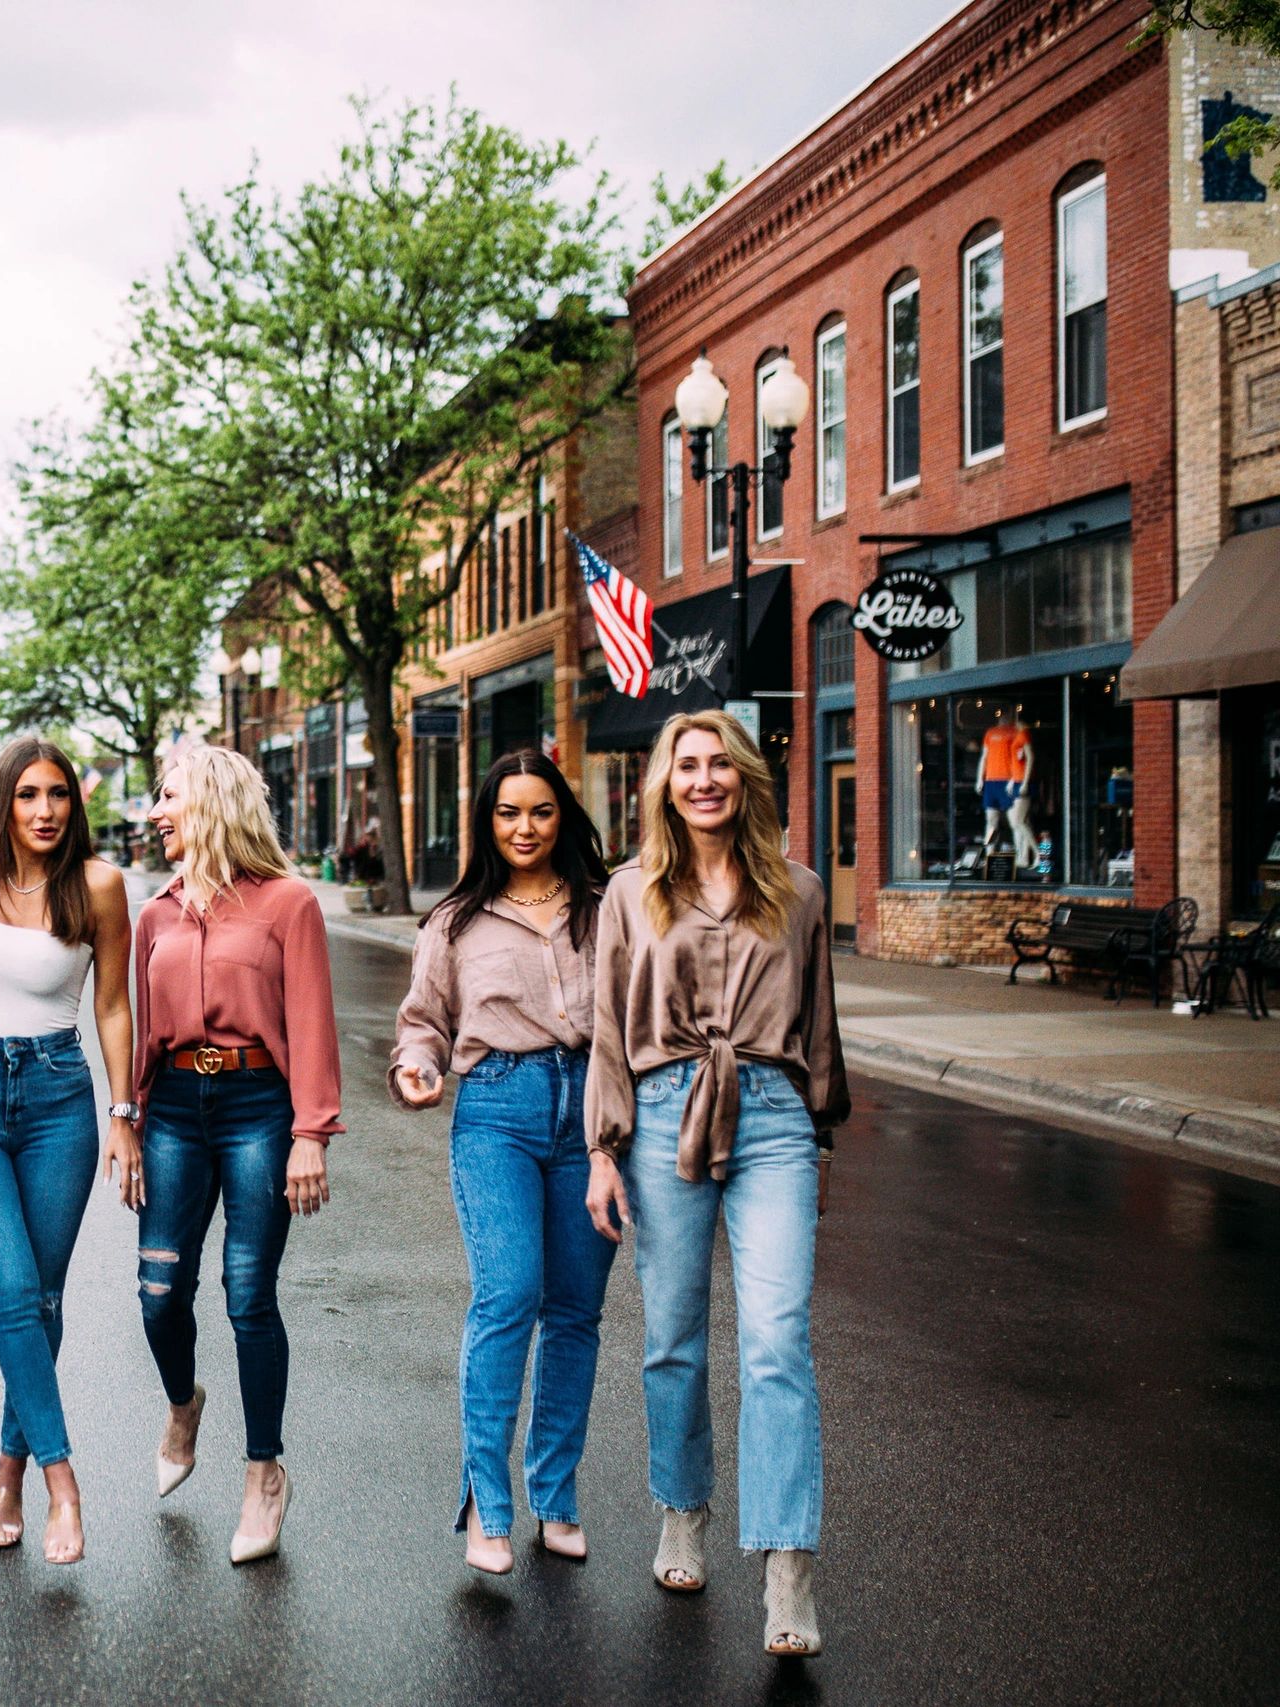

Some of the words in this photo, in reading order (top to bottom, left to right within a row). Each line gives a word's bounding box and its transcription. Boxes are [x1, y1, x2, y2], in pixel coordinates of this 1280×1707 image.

[884, 571, 938, 592] RUNNING
[895, 593, 913, 605] the
[853, 589, 963, 637] Lakes
[878, 638, 935, 659] COMPANY
